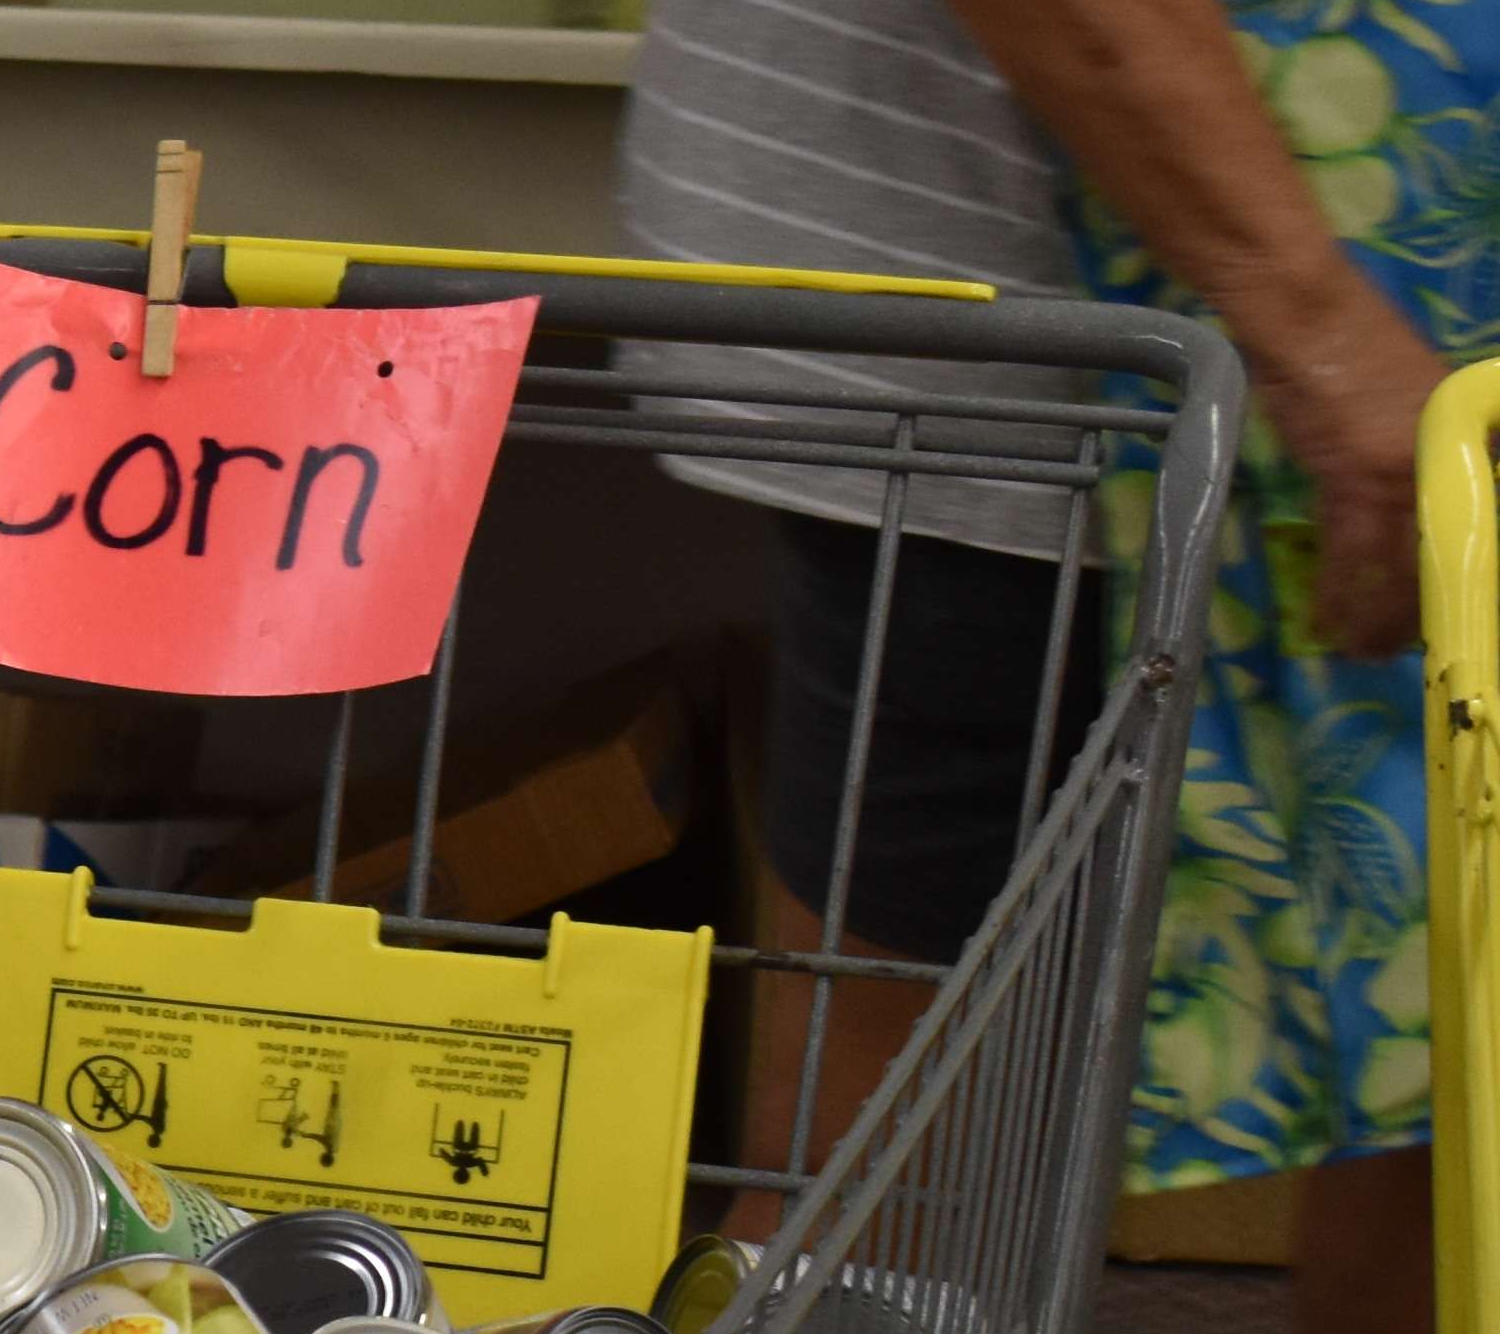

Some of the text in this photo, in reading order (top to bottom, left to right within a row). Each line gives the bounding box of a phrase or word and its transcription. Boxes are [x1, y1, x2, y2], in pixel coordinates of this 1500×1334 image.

[163, 1008, 179, 1020] TO
[181, 1010, 198, 1022] UP
[238, 1016, 264, 1028] AND
[142, 1044, 169, 1057] NOT
[171, 1047, 192, 1059] DO
[260, 1187, 303, 1204] suffer
[305, 1193, 332, 1208] and
[334, 1196, 363, 1211] cart
[365, 1201, 381, 1214] of
[381, 1204, 406, 1217] out
[409, 1205, 430, 1221] fall
[431, 1211, 459, 1224] can
[460, 1211, 496, 1227] child
[497, 1217, 534, 1234] Your
